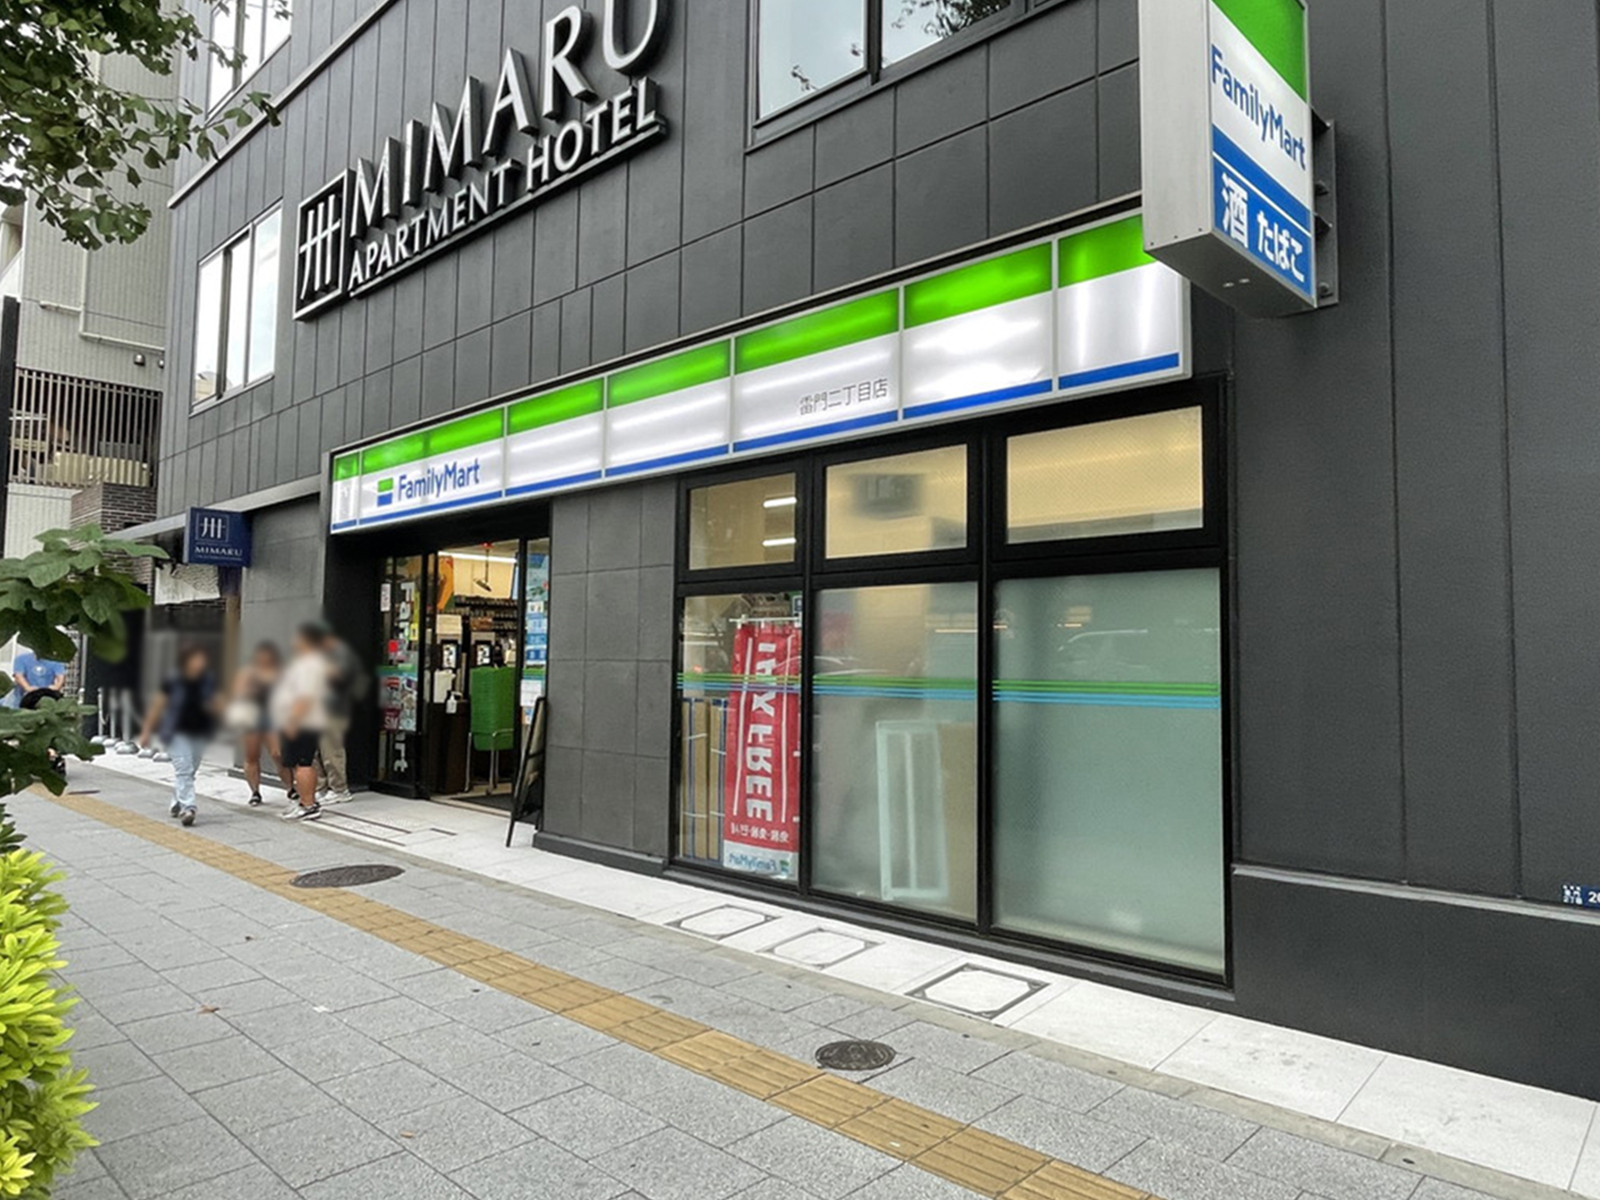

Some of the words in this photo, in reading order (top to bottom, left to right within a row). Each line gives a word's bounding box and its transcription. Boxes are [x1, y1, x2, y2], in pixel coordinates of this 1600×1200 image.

[350, 0, 663, 238] MIMARU
[1211, 44, 1306, 170] FamilyMart
[347, 159, 521, 289] APARTMENT
[526, 76, 663, 193] HOTEL
[1221, 172, 1249, 249] 酒
[1256, 210, 1305, 282] たばこ
[397, 458, 480, 501] FamilyMart
[195, 546, 243, 556] MIMARU
